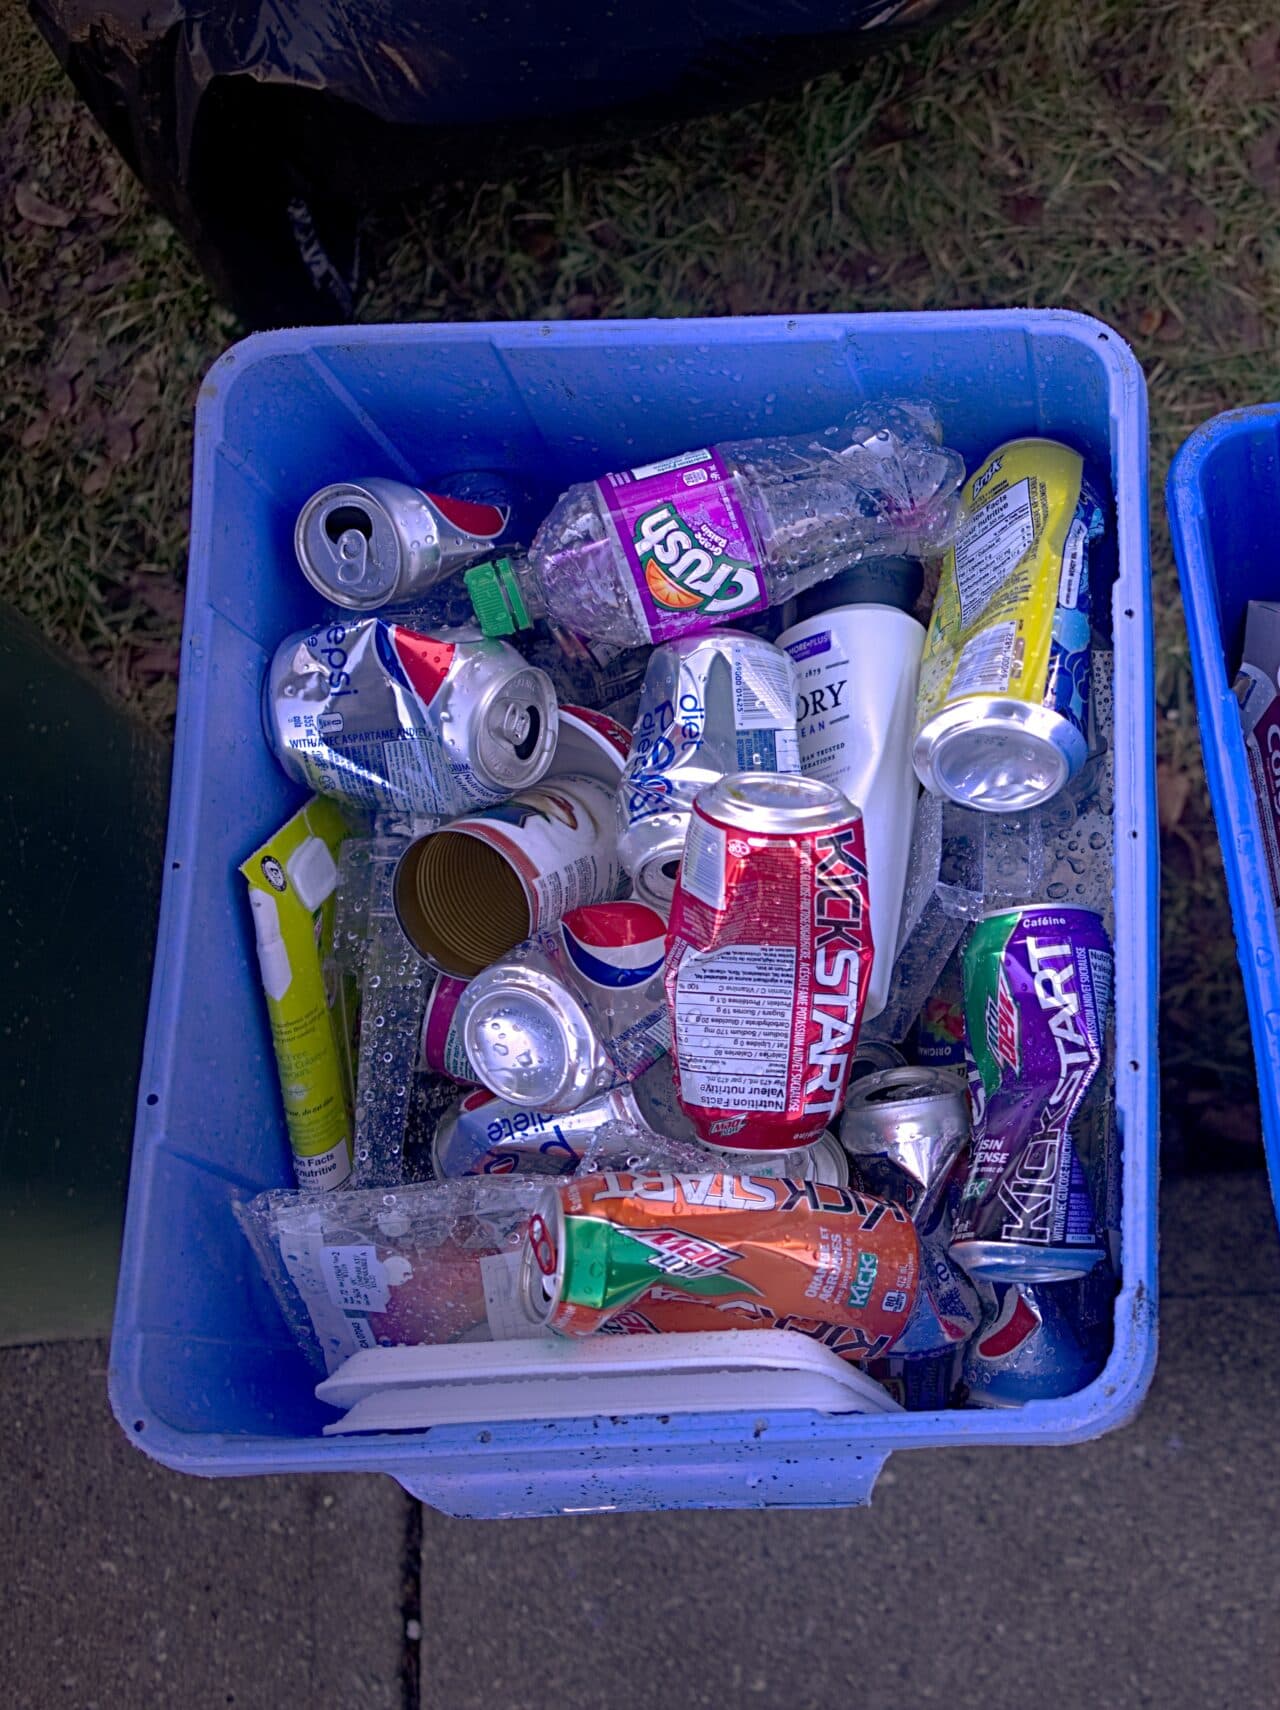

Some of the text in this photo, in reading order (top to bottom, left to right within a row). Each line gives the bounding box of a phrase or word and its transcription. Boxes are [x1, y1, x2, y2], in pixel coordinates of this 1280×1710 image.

[985, 493, 1008, 512] Facts
[976, 501, 1009, 528] nutritive
[701, 523, 728, 548] Raisin
[695, 532, 722, 556] Grape
[635, 508, 760, 611] Crush
[317, 624, 358, 698] epsi
[735, 686, 744, 712] 01425
[671, 691, 711, 753] diet
[815, 741, 845, 757] TRUSTED
[1022, 916, 1066, 928] Caféine
[795, 961, 810, 1005] ACÉSULFAME
[804, 831, 866, 1120] KICKSTART
[686, 982, 699, 990] 100
[717, 984, 724, 992] C
[725, 985, 754, 994] Vitamine
[766, 987, 791, 996] Vitamin
[716, 996, 791, 1008] Protein Protéines 0.1
[1076, 946, 1101, 1047] POTASSIUM AND/ET SUCRALOSE
[731, 1007, 756, 1016] Sucres
[761, 1008, 785, 1018] Sugars
[710, 1016, 739, 1025] Glucides
[744, 1017, 789, 1029] Carbohydrate
[793, 1006, 807, 1046] POTASSIUM
[703, 1025, 788, 1039] Sodium Sodium 170 mg
[745, 1038, 788, 1049] Fat Lipides
[723, 1048, 787, 1060] Calories Calories
[791, 1046, 804, 1072] AND/ET
[716, 1075, 729, 1083] 473
[759, 1078, 771, 1086] 473
[699, 1082, 785, 1098] Valeur nutritive
[787, 1072, 802, 1113] SUCRALOSE
[998, 935, 1091, 1242] KICKSTART
[699, 1094, 784, 1110] Nutrition Facts
[486, 1110, 553, 1141] diète
[307, 1152, 334, 1167] Facts
[298, 1162, 337, 1176] nutritive
[590, 1173, 907, 1230] KICKSTART
[1052, 1200, 1067, 1242] WITH/AVEC
[819, 1225, 828, 1239] ET
[848, 1251, 877, 1305] KICK
